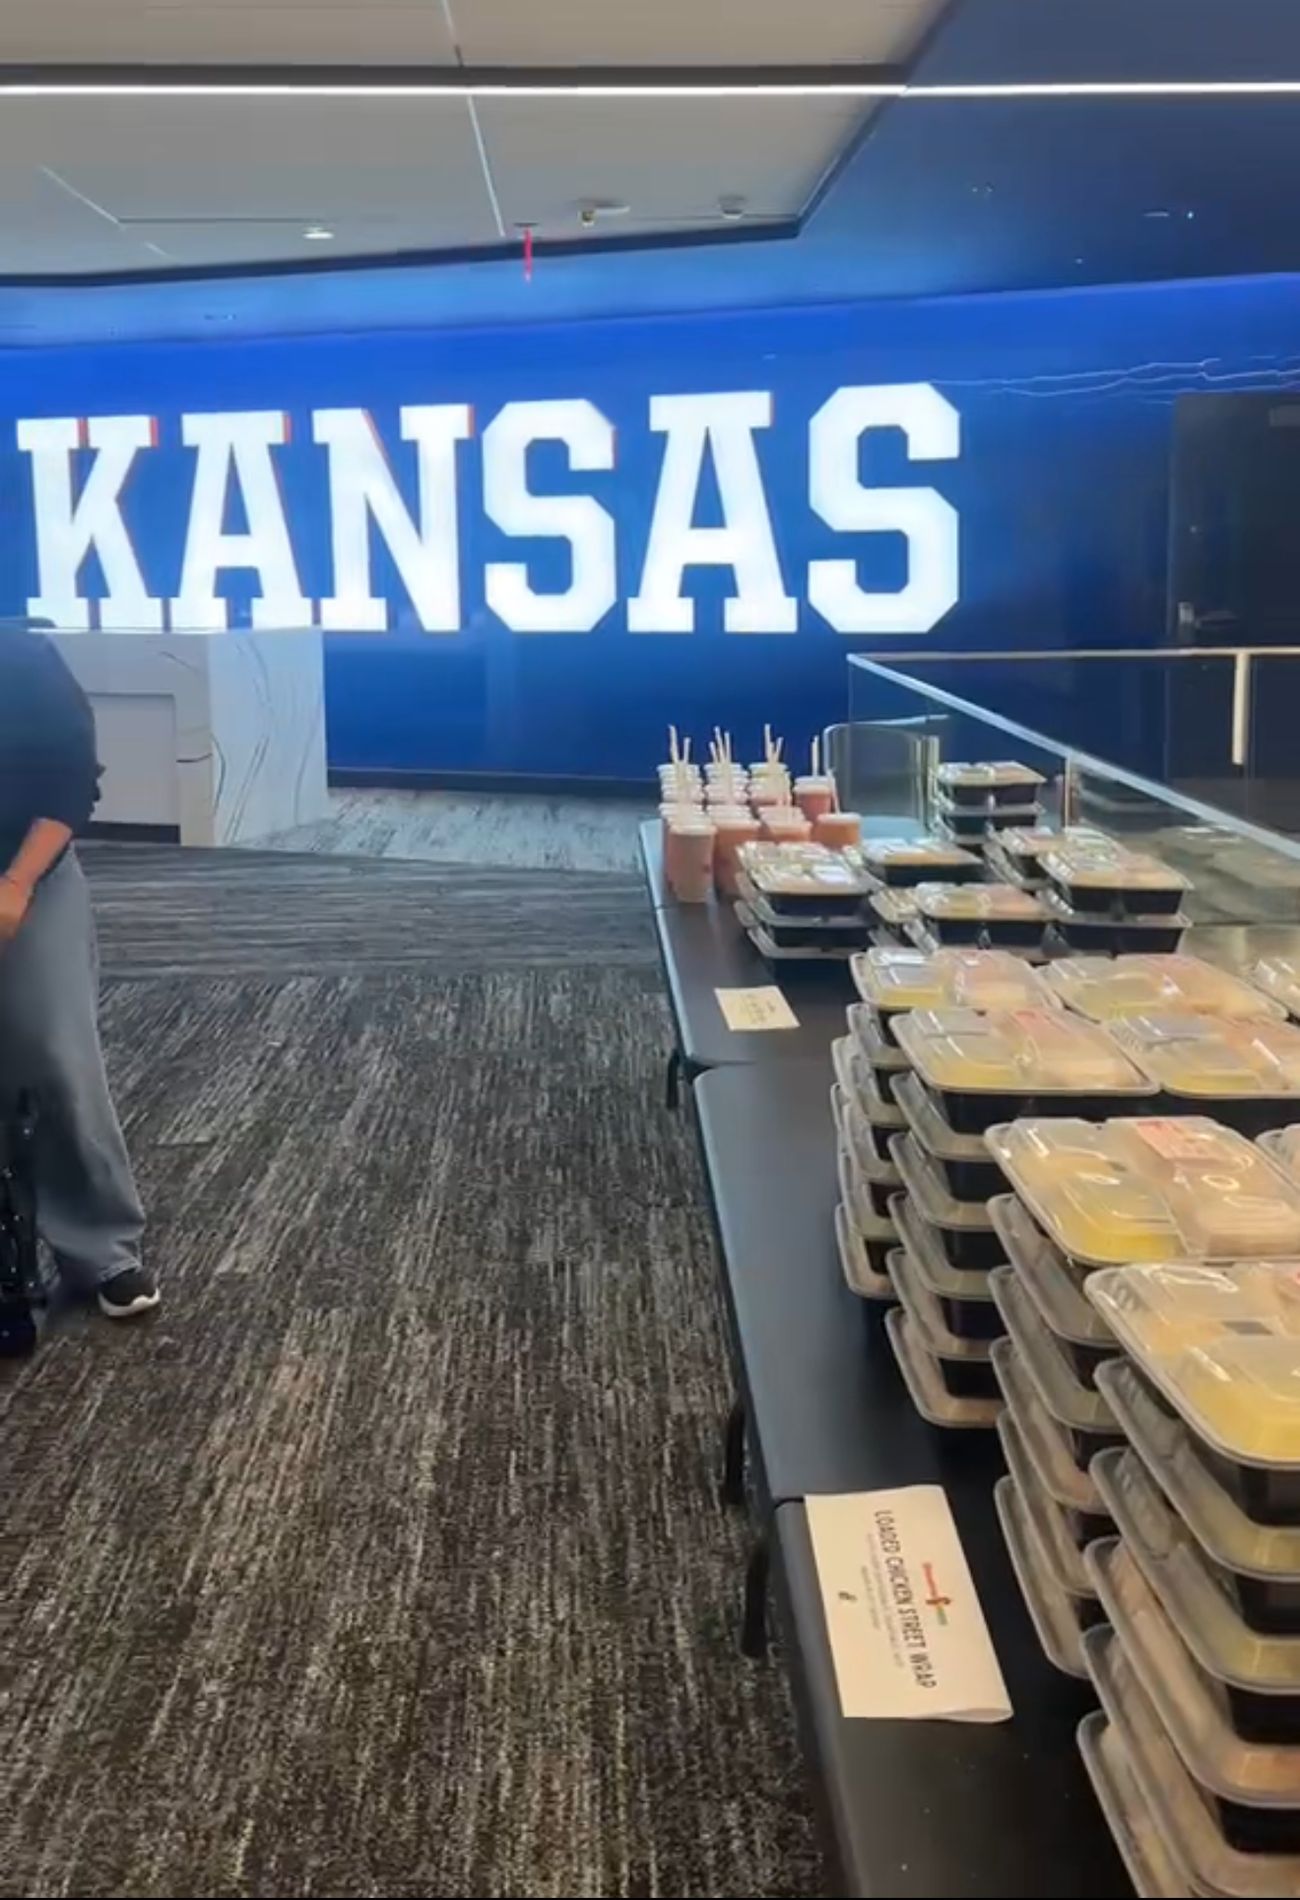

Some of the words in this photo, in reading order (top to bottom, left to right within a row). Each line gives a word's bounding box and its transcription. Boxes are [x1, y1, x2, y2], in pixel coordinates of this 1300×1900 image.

[16, 382, 961, 633] KANSAS
[874, 1509, 901, 1553] LOADED
[885, 1556, 913, 1605] CHICKEN
[897, 1608, 927, 1648] STREET
[909, 1653, 938, 1688] WRAP
